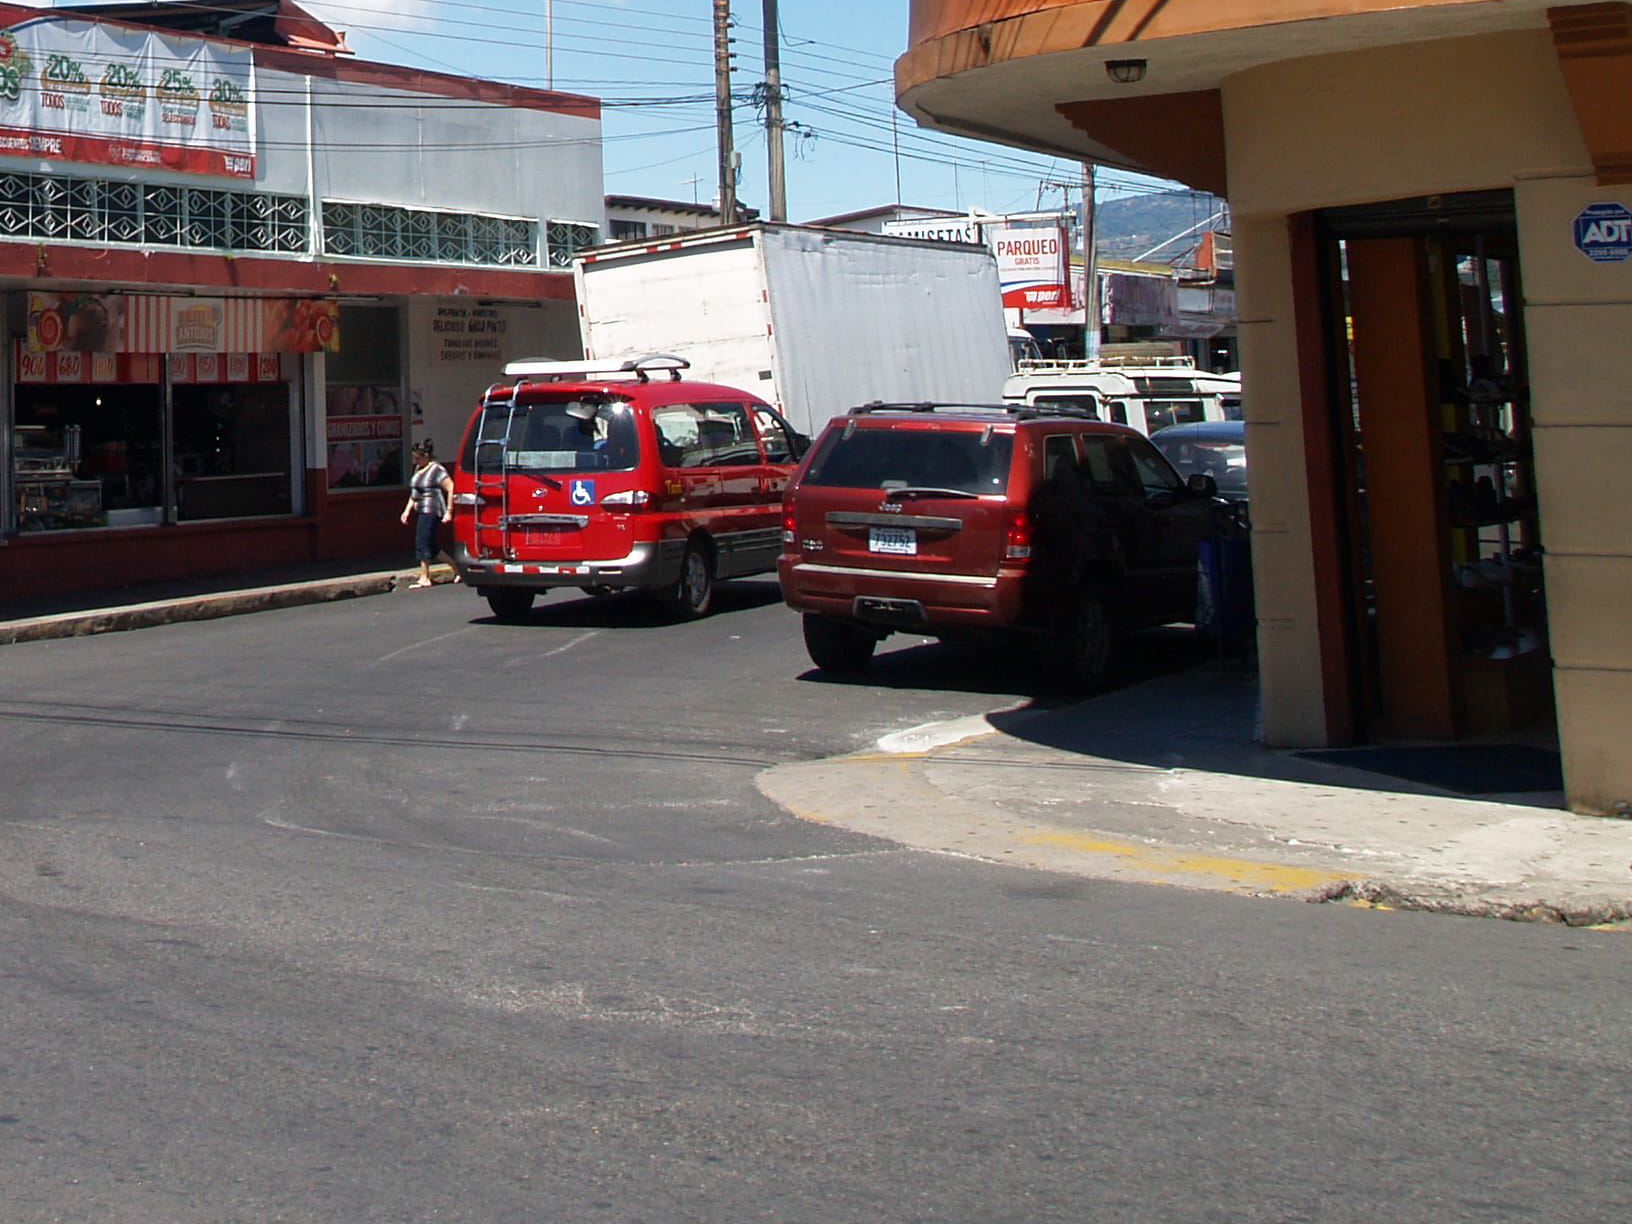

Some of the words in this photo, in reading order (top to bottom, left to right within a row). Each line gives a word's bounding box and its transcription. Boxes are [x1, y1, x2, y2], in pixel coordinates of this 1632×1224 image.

[1582, 219, 1632, 244] ADT
[997, 238, 1058, 257] PARQUEO
[878, 500, 903, 513] Jeep
